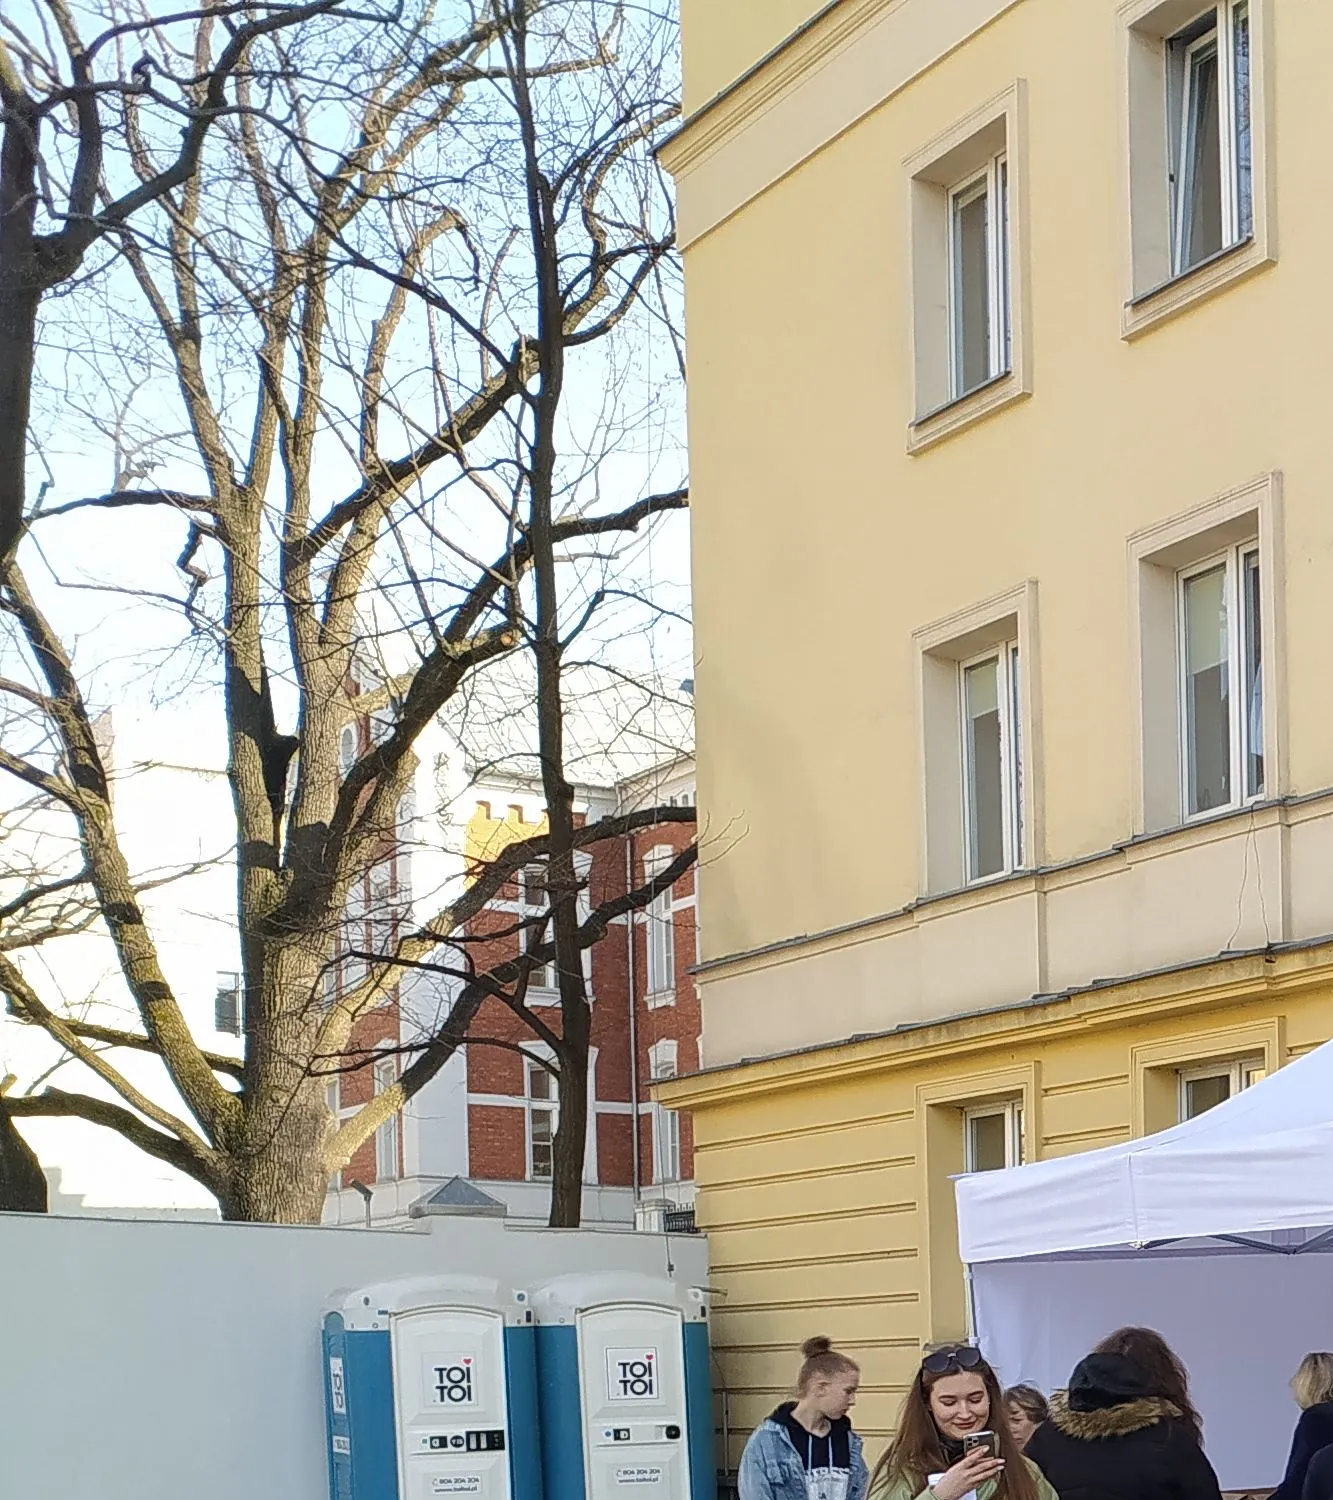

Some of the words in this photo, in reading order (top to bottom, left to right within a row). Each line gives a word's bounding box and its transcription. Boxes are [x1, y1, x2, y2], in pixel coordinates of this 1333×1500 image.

[433, 1366, 471, 1384] TOI
[617, 1361, 653, 1378] TOI
[434, 1384, 472, 1402] TOI
[618, 1378, 653, 1396] TOI
